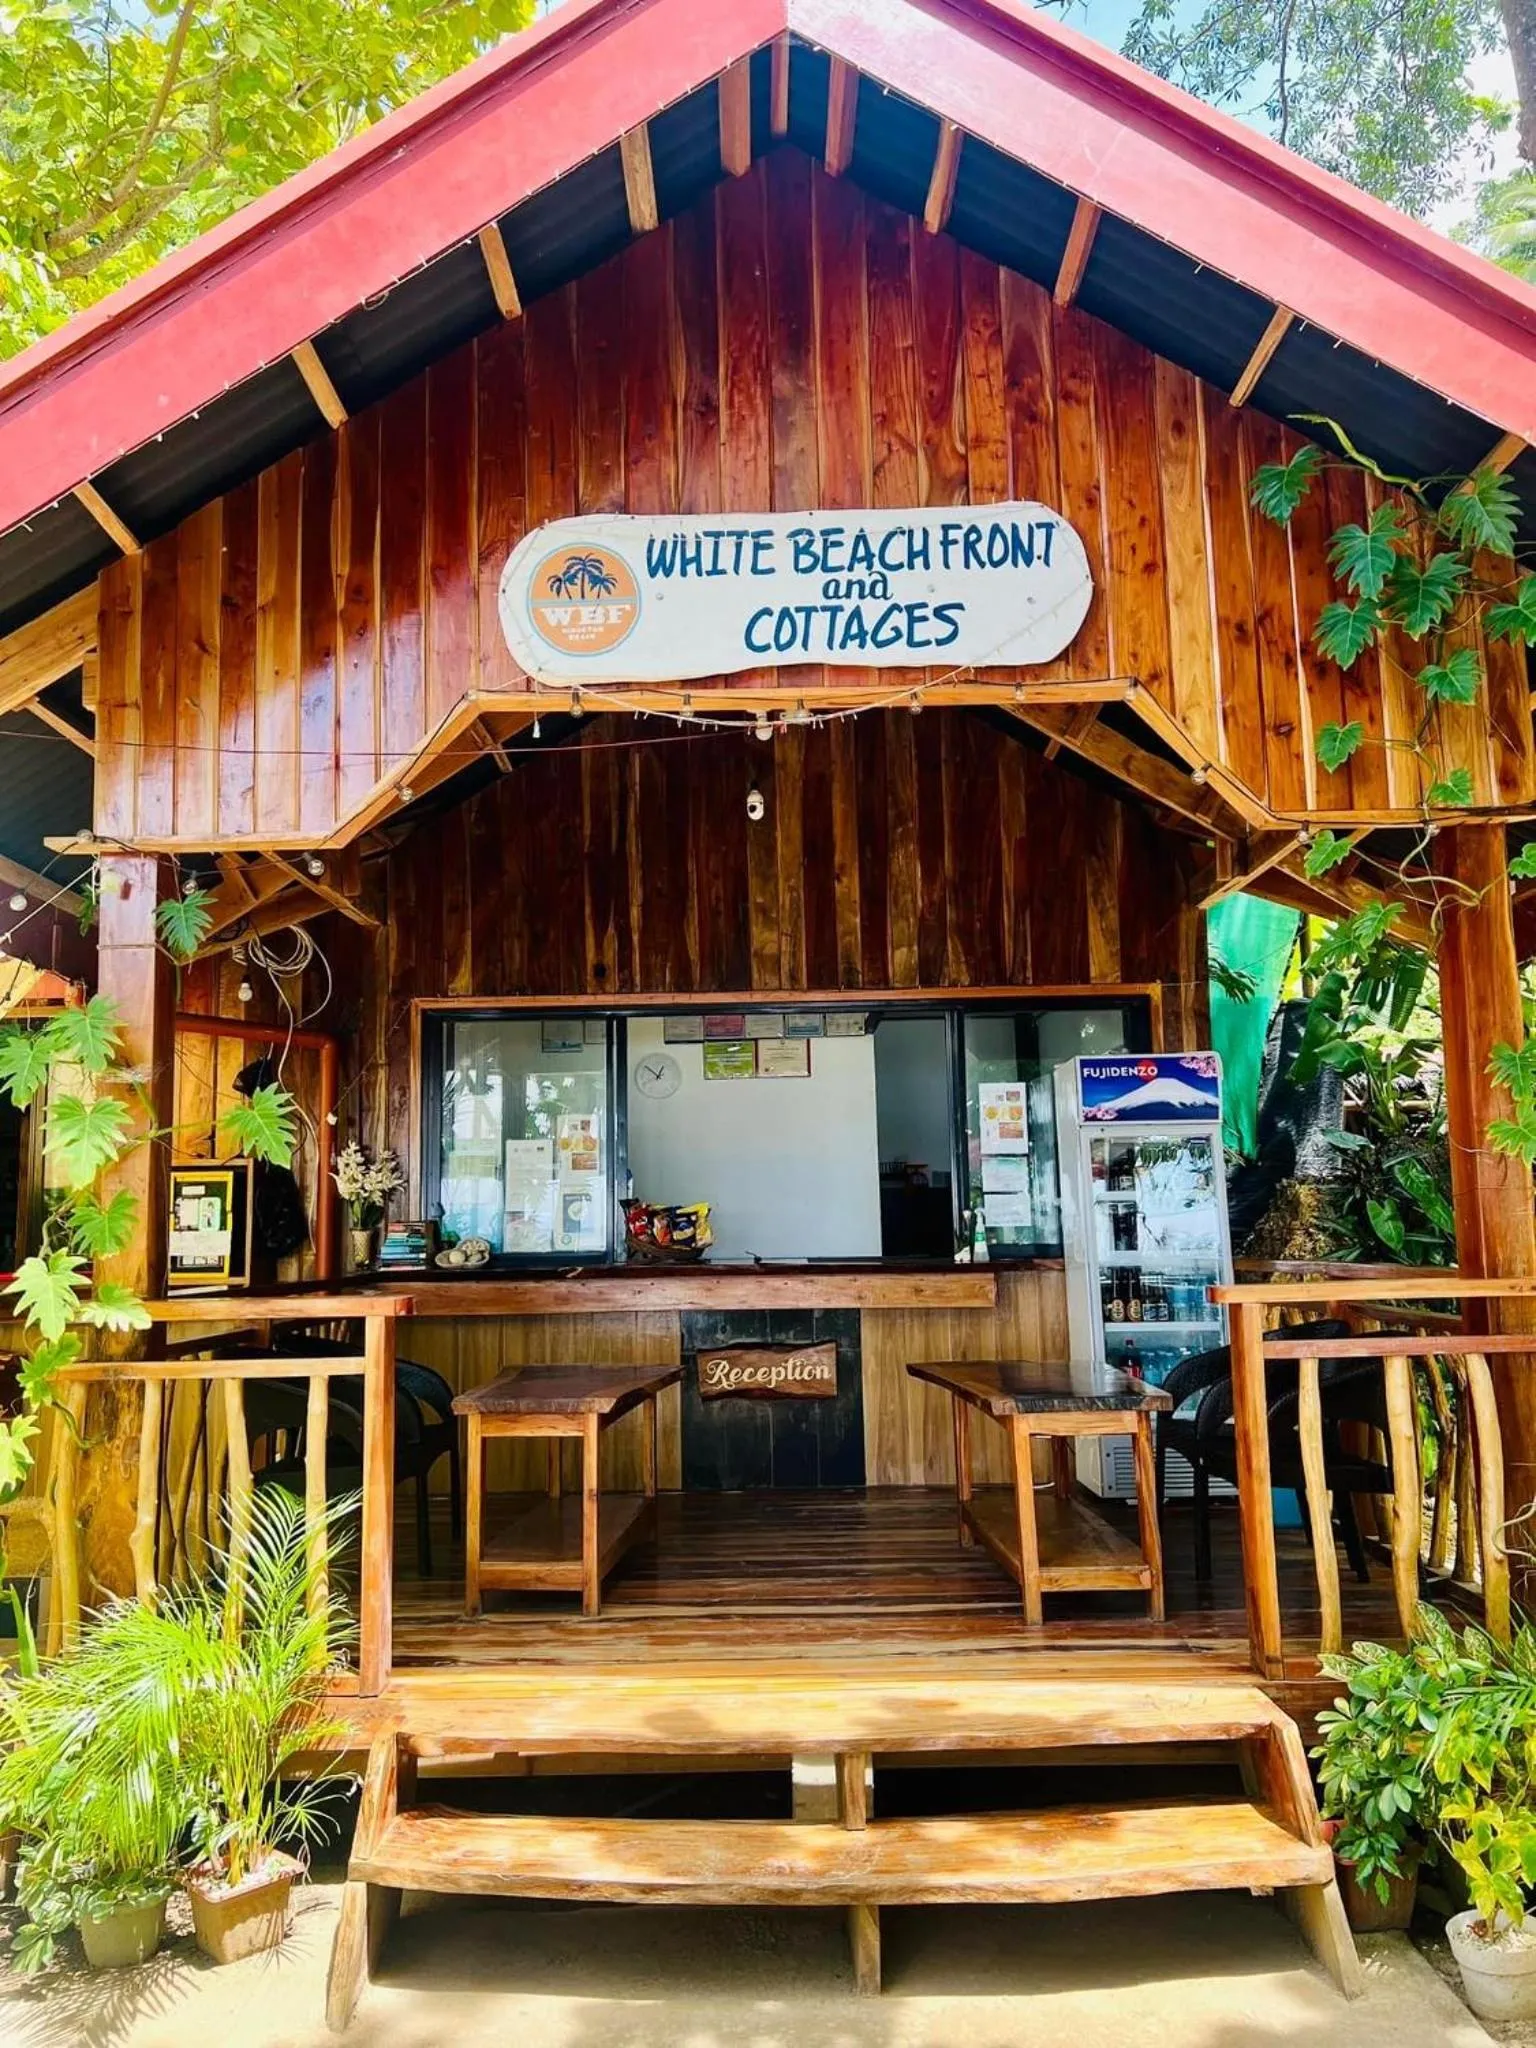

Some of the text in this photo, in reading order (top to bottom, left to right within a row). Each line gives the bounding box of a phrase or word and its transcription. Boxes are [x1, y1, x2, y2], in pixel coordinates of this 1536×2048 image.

[645, 521, 1061, 579] WHITE BEACH FRONT
[821, 571, 893, 601] and
[541, 604, 632, 627] WBF
[743, 602, 967, 654] COTTAGES
[1083, 1065, 1159, 1079] FUJIDENZO
[704, 1357, 832, 1390] Reception
